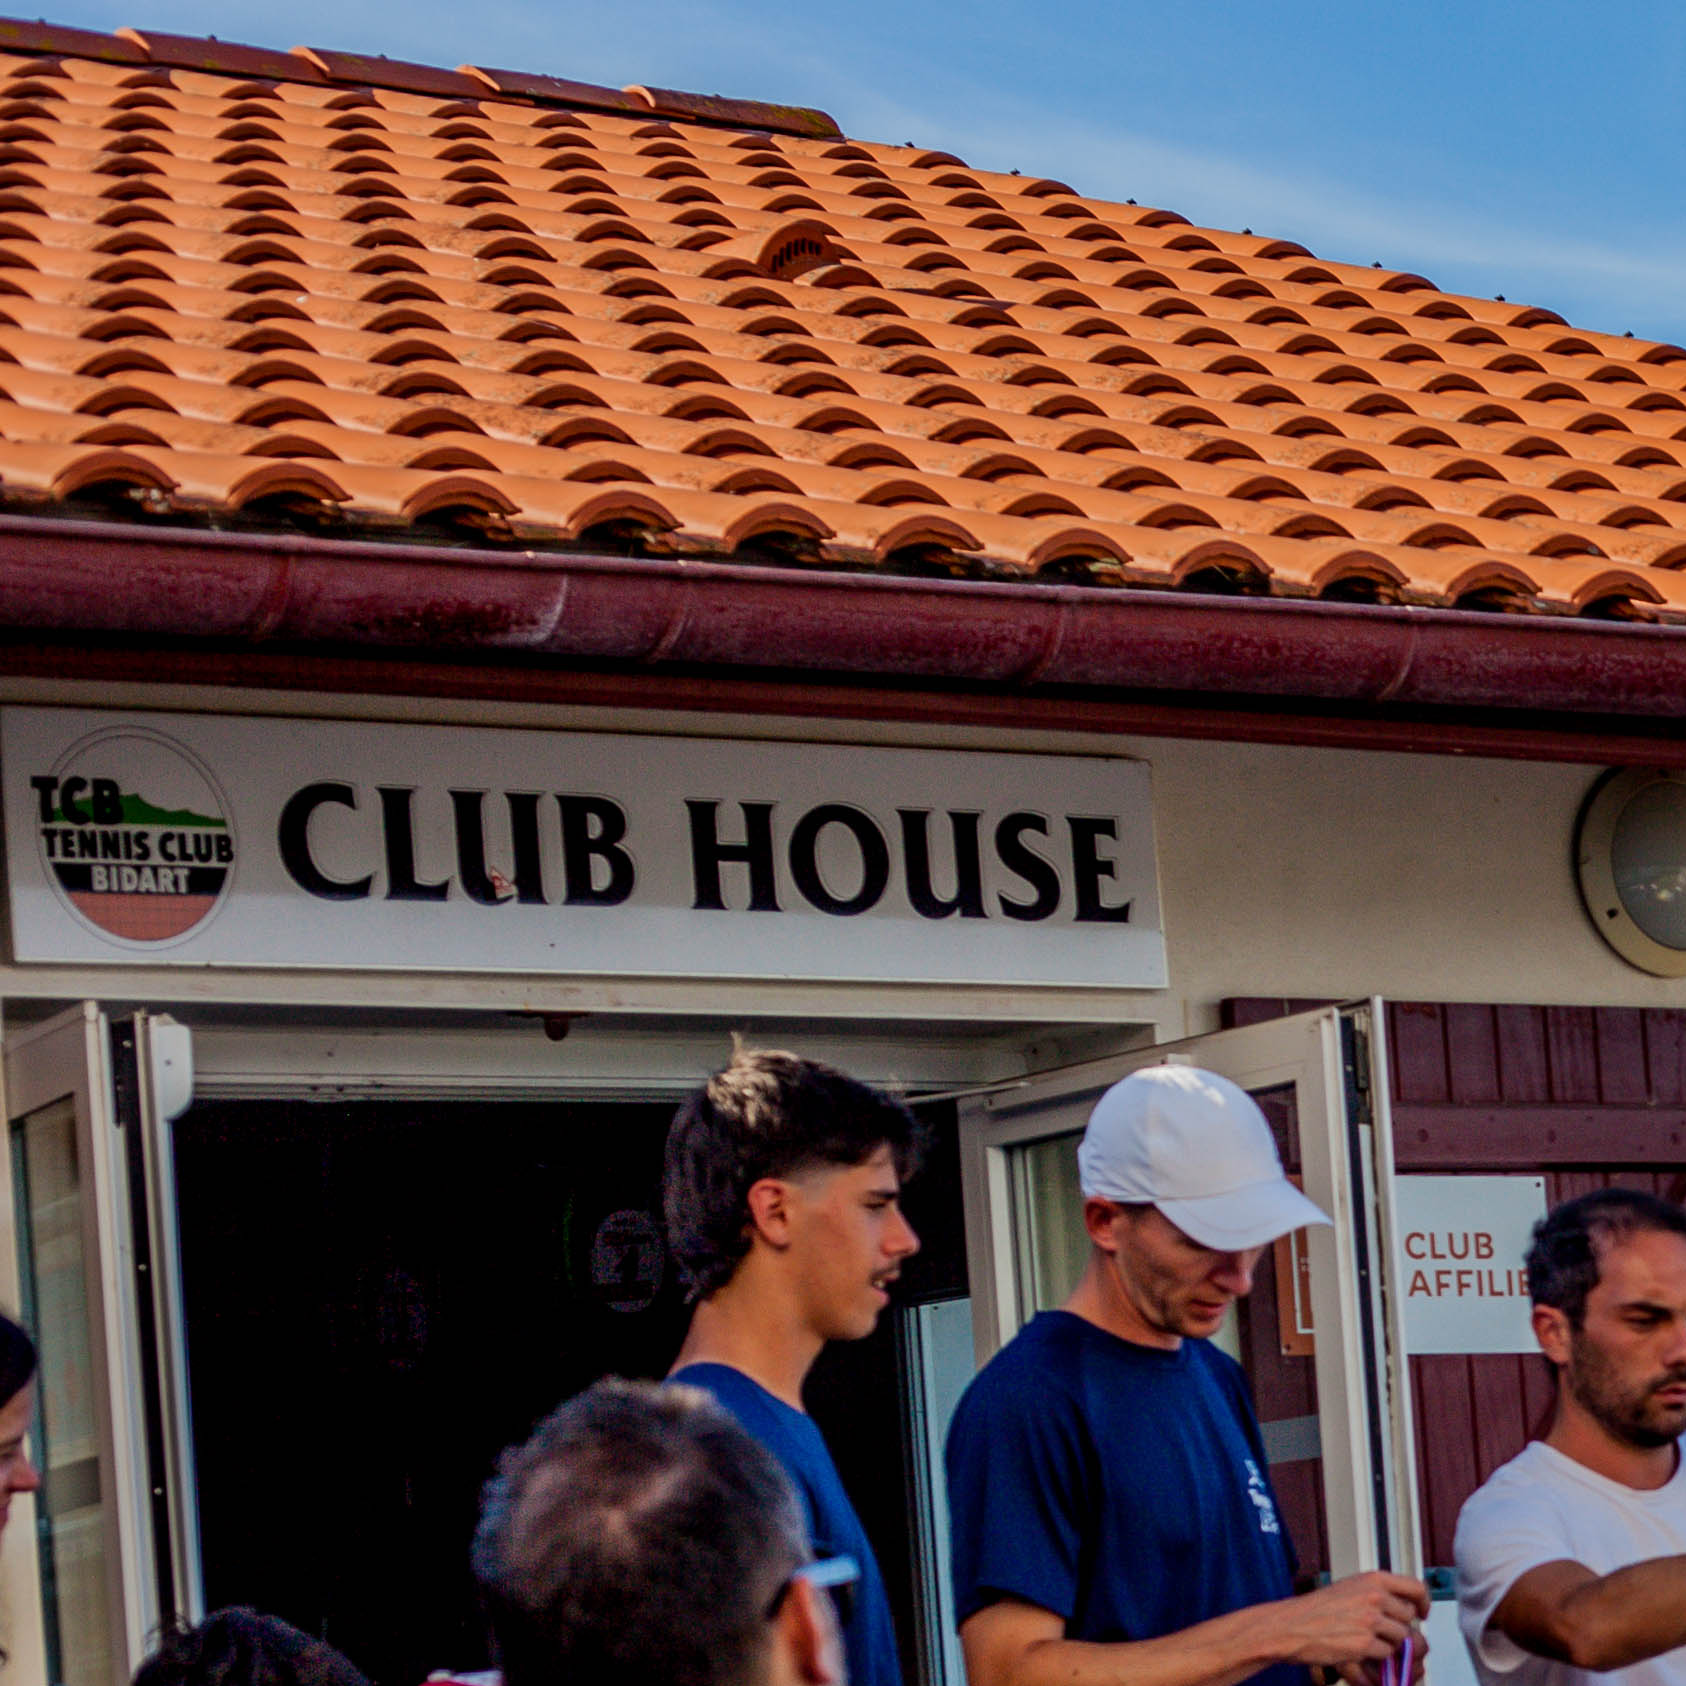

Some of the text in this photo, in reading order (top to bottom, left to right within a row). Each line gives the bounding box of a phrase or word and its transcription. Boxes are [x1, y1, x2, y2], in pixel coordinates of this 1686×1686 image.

[31, 776, 124, 825] TCB
[41, 829, 234, 863] TENNIS CLUB
[277, 782, 1134, 925] CLUB HOUSE
[91, 865, 190, 893] BIDART
[1404, 1232, 1494, 1259] CLUB
